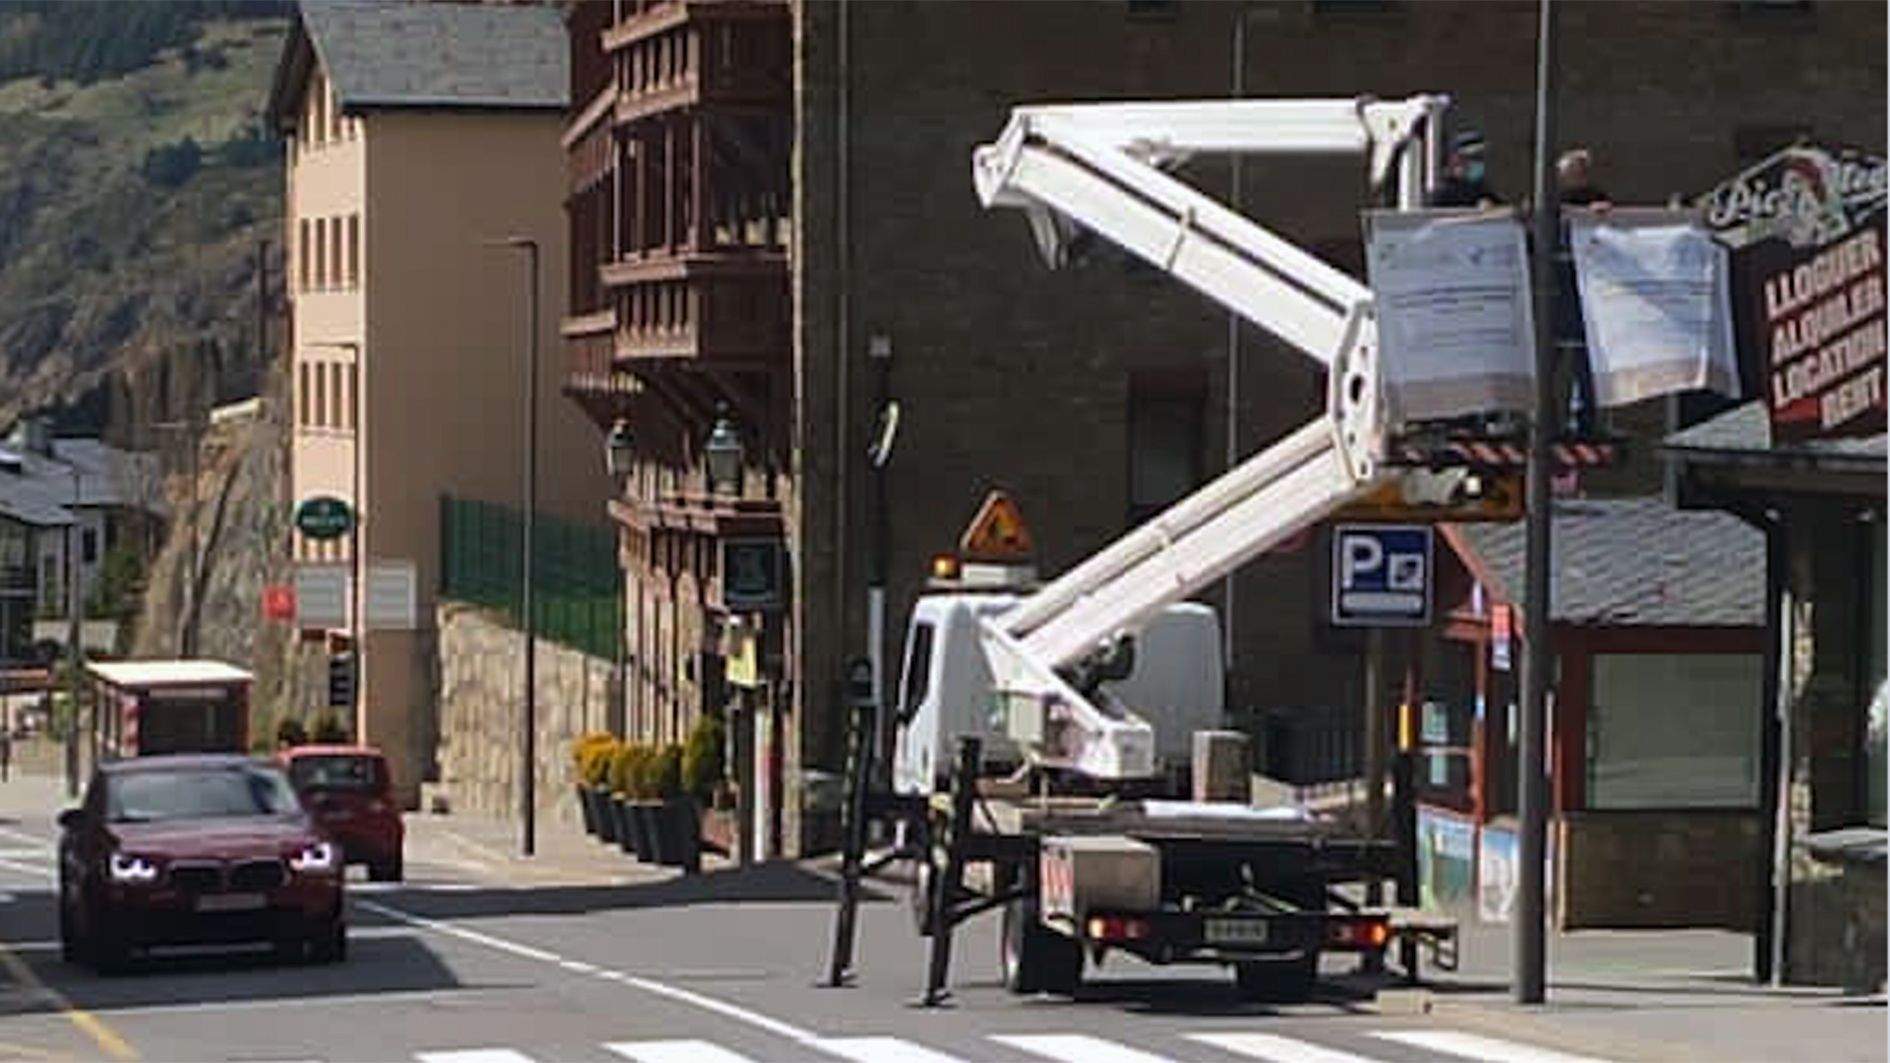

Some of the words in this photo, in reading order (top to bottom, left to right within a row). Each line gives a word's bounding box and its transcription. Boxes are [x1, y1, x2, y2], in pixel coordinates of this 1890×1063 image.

[1764, 229, 1881, 320] LLOGUER
[1771, 274, 1886, 366] ALQUILER
[1772, 319, 1887, 409] LOCATION
[1820, 366, 1882, 429] RENT
[1342, 535, 1382, 588] P
